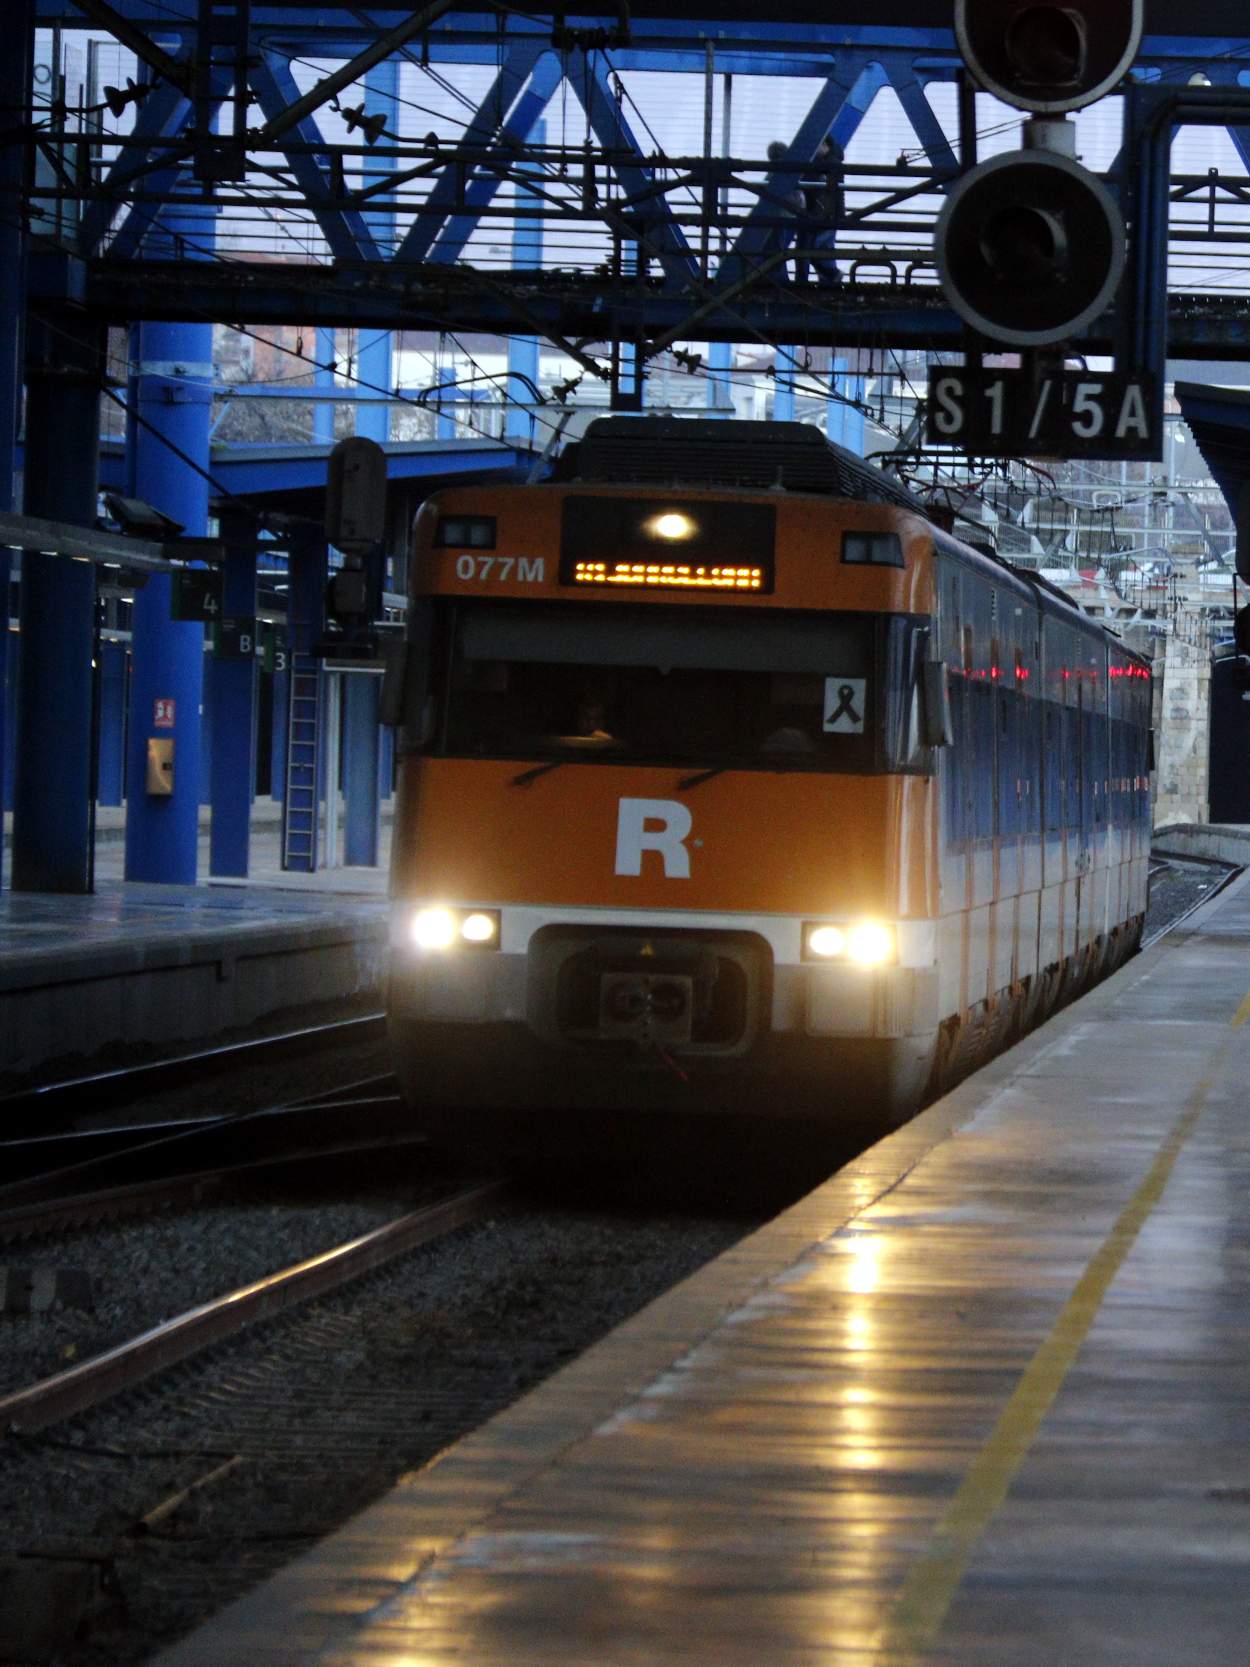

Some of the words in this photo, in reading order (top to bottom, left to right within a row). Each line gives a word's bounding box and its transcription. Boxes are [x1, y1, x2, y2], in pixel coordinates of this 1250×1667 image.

[455, 554, 545, 583] 077M
[203, 592, 218, 614] 4
[239, 635, 252, 653] B
[275, 652, 286, 671] 3
[614, 798, 693, 880] R
